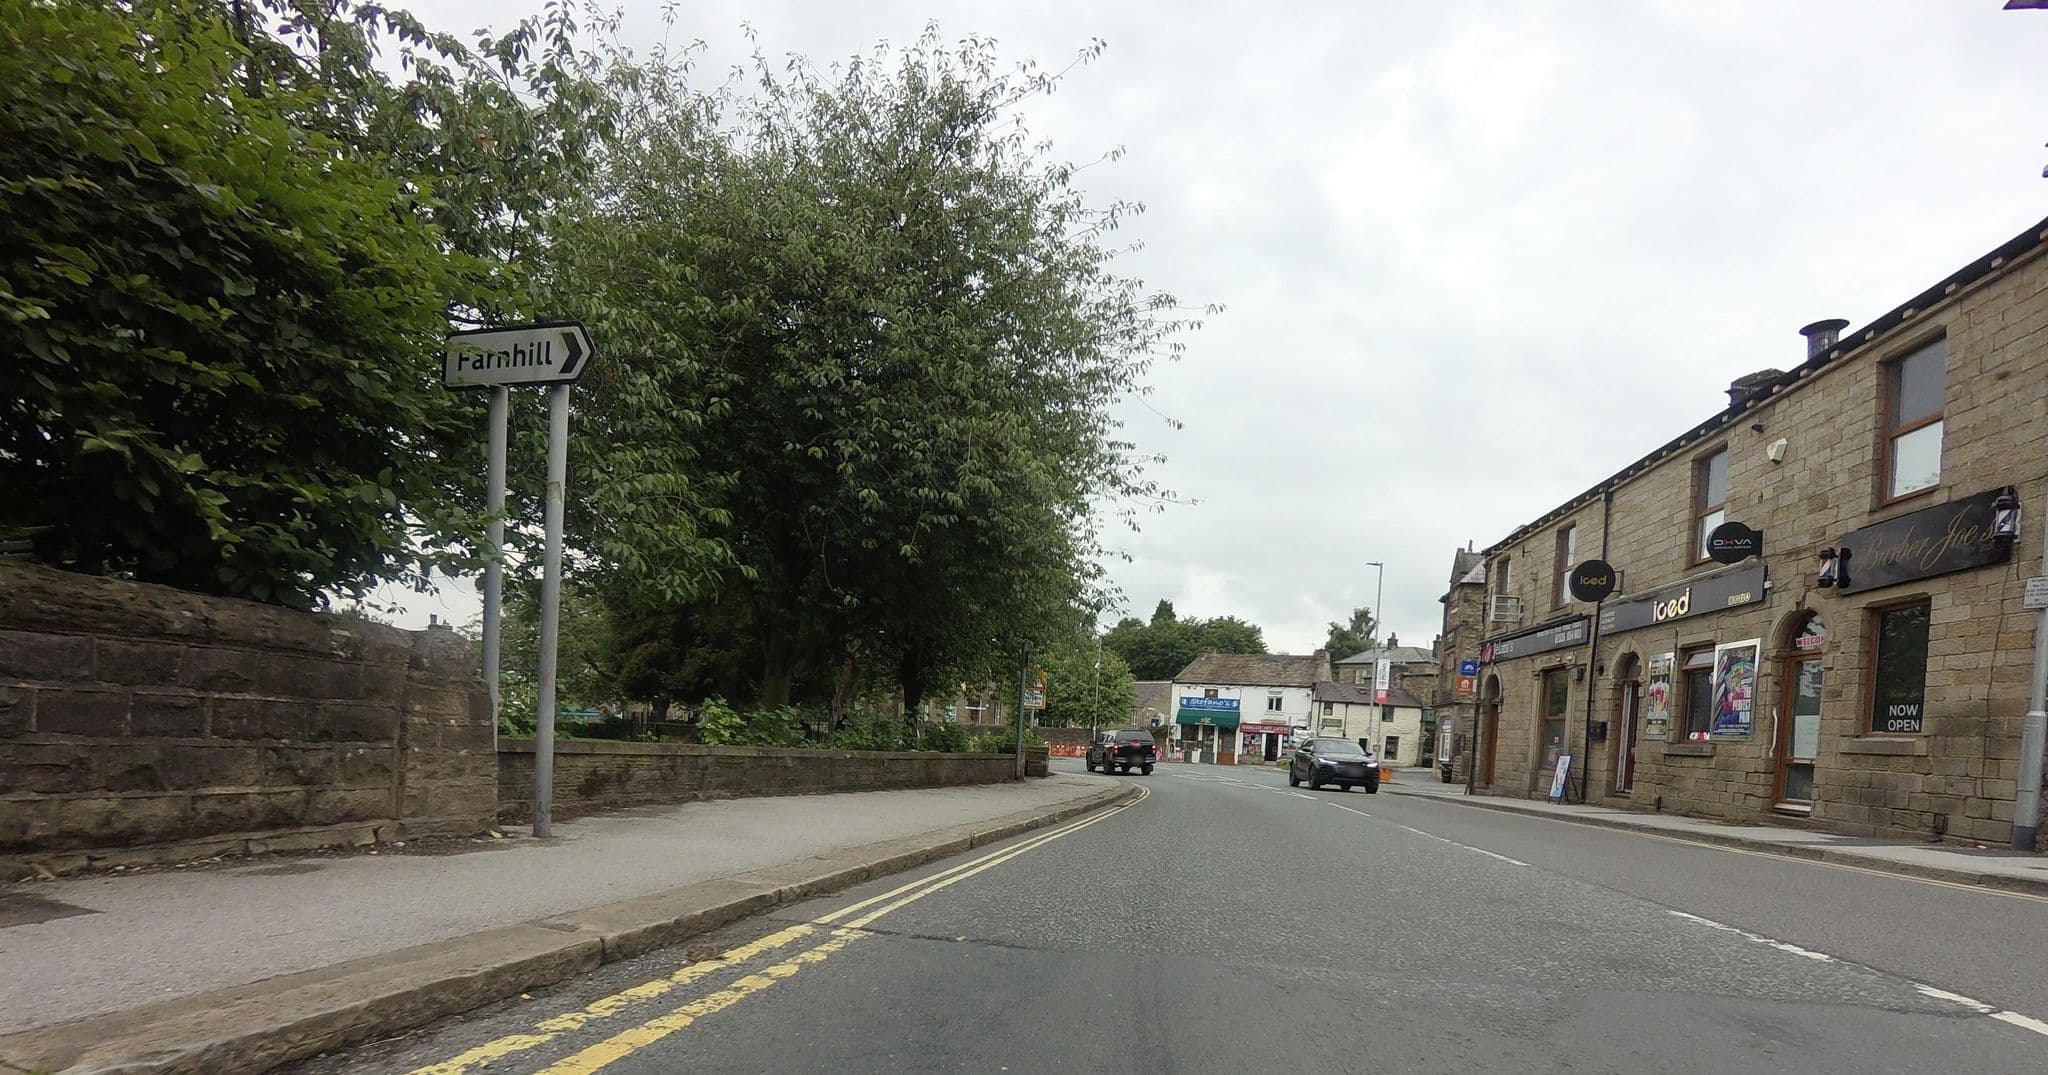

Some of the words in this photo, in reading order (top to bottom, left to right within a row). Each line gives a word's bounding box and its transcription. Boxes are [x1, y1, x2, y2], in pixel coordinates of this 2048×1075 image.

[458, 341, 552, 371] Farnhill
[1713, 538, 1752, 546] OXVA
[1857, 526, 1930, 572] Barber
[1653, 587, 1690, 621] iced
[1889, 704, 1919, 716] NOW
[1888, 719, 1919, 731] OPEN
